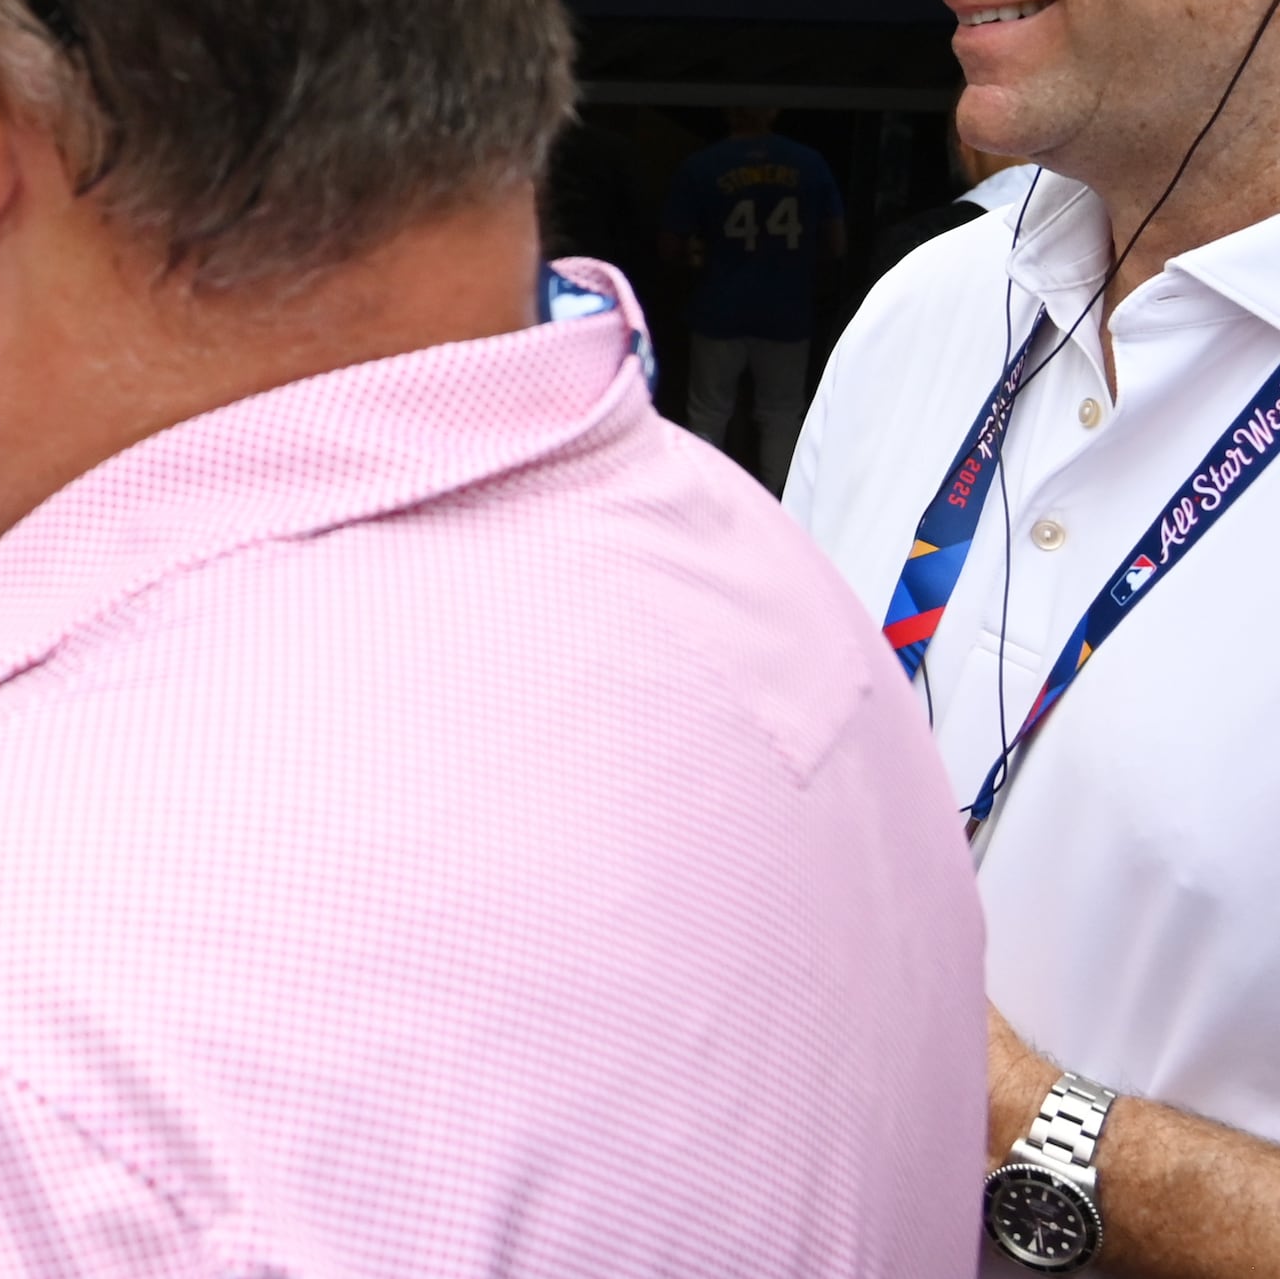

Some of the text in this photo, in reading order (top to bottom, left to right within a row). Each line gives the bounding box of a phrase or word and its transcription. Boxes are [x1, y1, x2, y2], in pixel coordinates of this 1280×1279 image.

[723, 196, 804, 252] 44
[948, 457, 982, 509] 2025
[1160, 398, 1280, 564] All Star We
